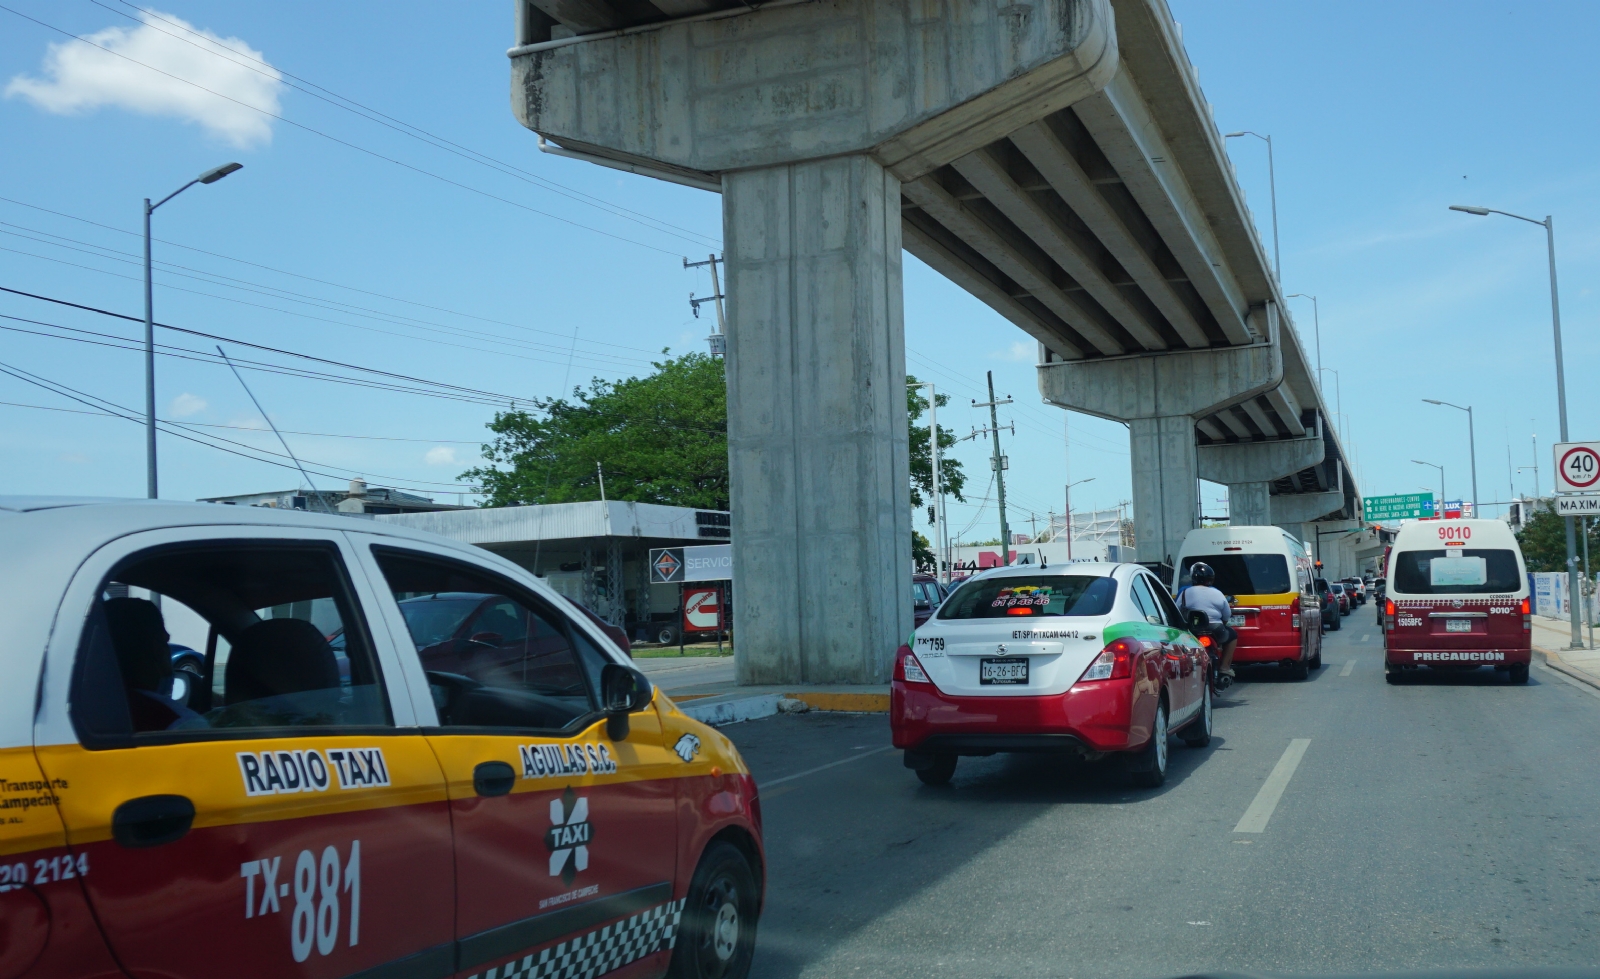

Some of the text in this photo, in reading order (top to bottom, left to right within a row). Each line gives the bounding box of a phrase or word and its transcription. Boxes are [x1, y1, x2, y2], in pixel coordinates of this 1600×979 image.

[1571, 454, 1594, 473] 40
[1438, 526, 1472, 540] 9010
[686, 591, 714, 615] Cummins
[1490, 606, 1511, 615] 9010
[1413, 651, 1505, 661] PRECAUCIÓN
[236, 747, 392, 797] RADIO TAXI
[519, 742, 617, 780] AGUILAS S.C.
[0, 778, 69, 794] Transporte
[0, 792, 61, 812] ampeche
[551, 823, 589, 847] TAXI
[33, 851, 89, 885] 2124
[240, 838, 361, 964] TX-881
